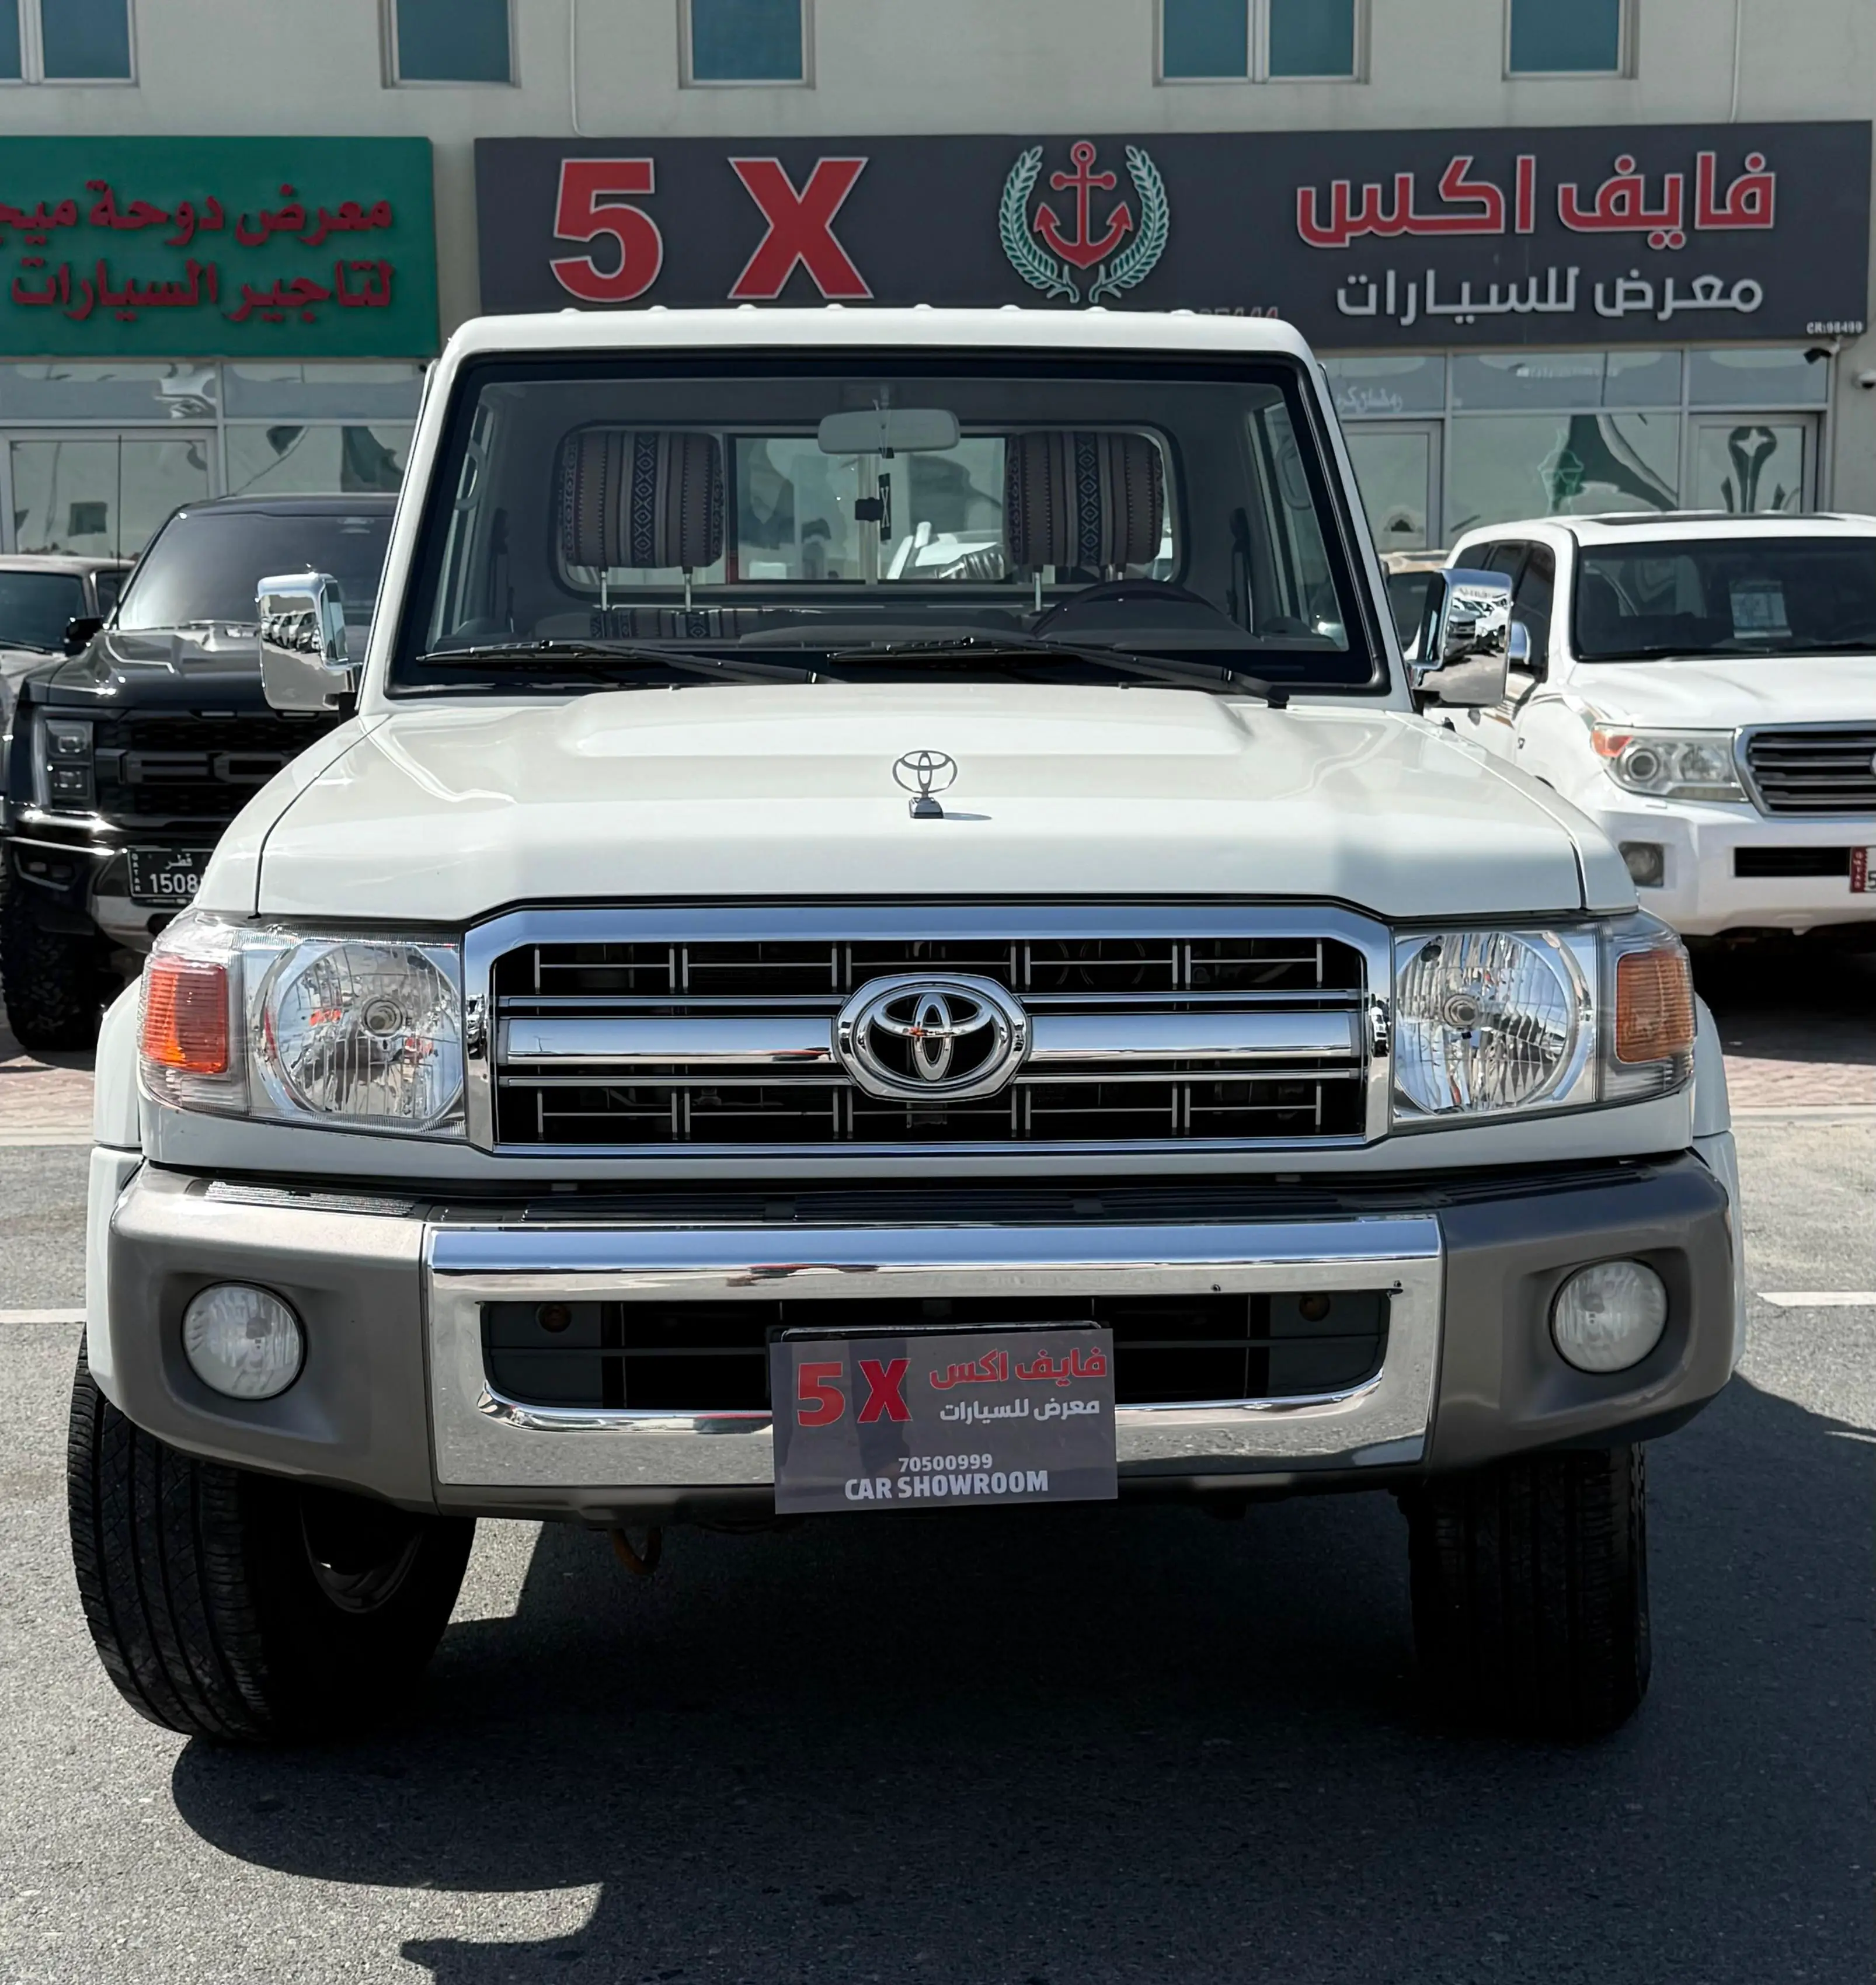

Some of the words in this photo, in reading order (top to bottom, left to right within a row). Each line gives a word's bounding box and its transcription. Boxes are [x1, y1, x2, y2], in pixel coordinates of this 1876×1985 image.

[86, 179, 224, 246] دوحة
[236, 183, 393, 246] معرض
[1296, 154, 1536, 248] اكس
[1557, 150, 1776, 250] فايف
[549, 158, 663, 302] 5
[727, 156, 874, 299] X
[12, 257, 218, 322] السيارات
[1336, 266, 1580, 326] للسيارات
[1594, 268, 1763, 321] معرض
[149, 873, 200, 894] 1508
[164, 853, 193, 870] قطر
[797, 1361, 846, 1427] 5
[857, 1358, 913, 1423] X
[930, 1348, 1008, 1390] اكس
[1015, 1347, 1107, 1387] فايف
[939, 1398, 1030, 1425] للسيارات
[1033, 1397, 1100, 1422] معرض
[845, 1477, 893, 1501] CAR
[898, 1470, 1049, 1499] SHOWROOM
[899, 1453, 993, 1472] 70500999
